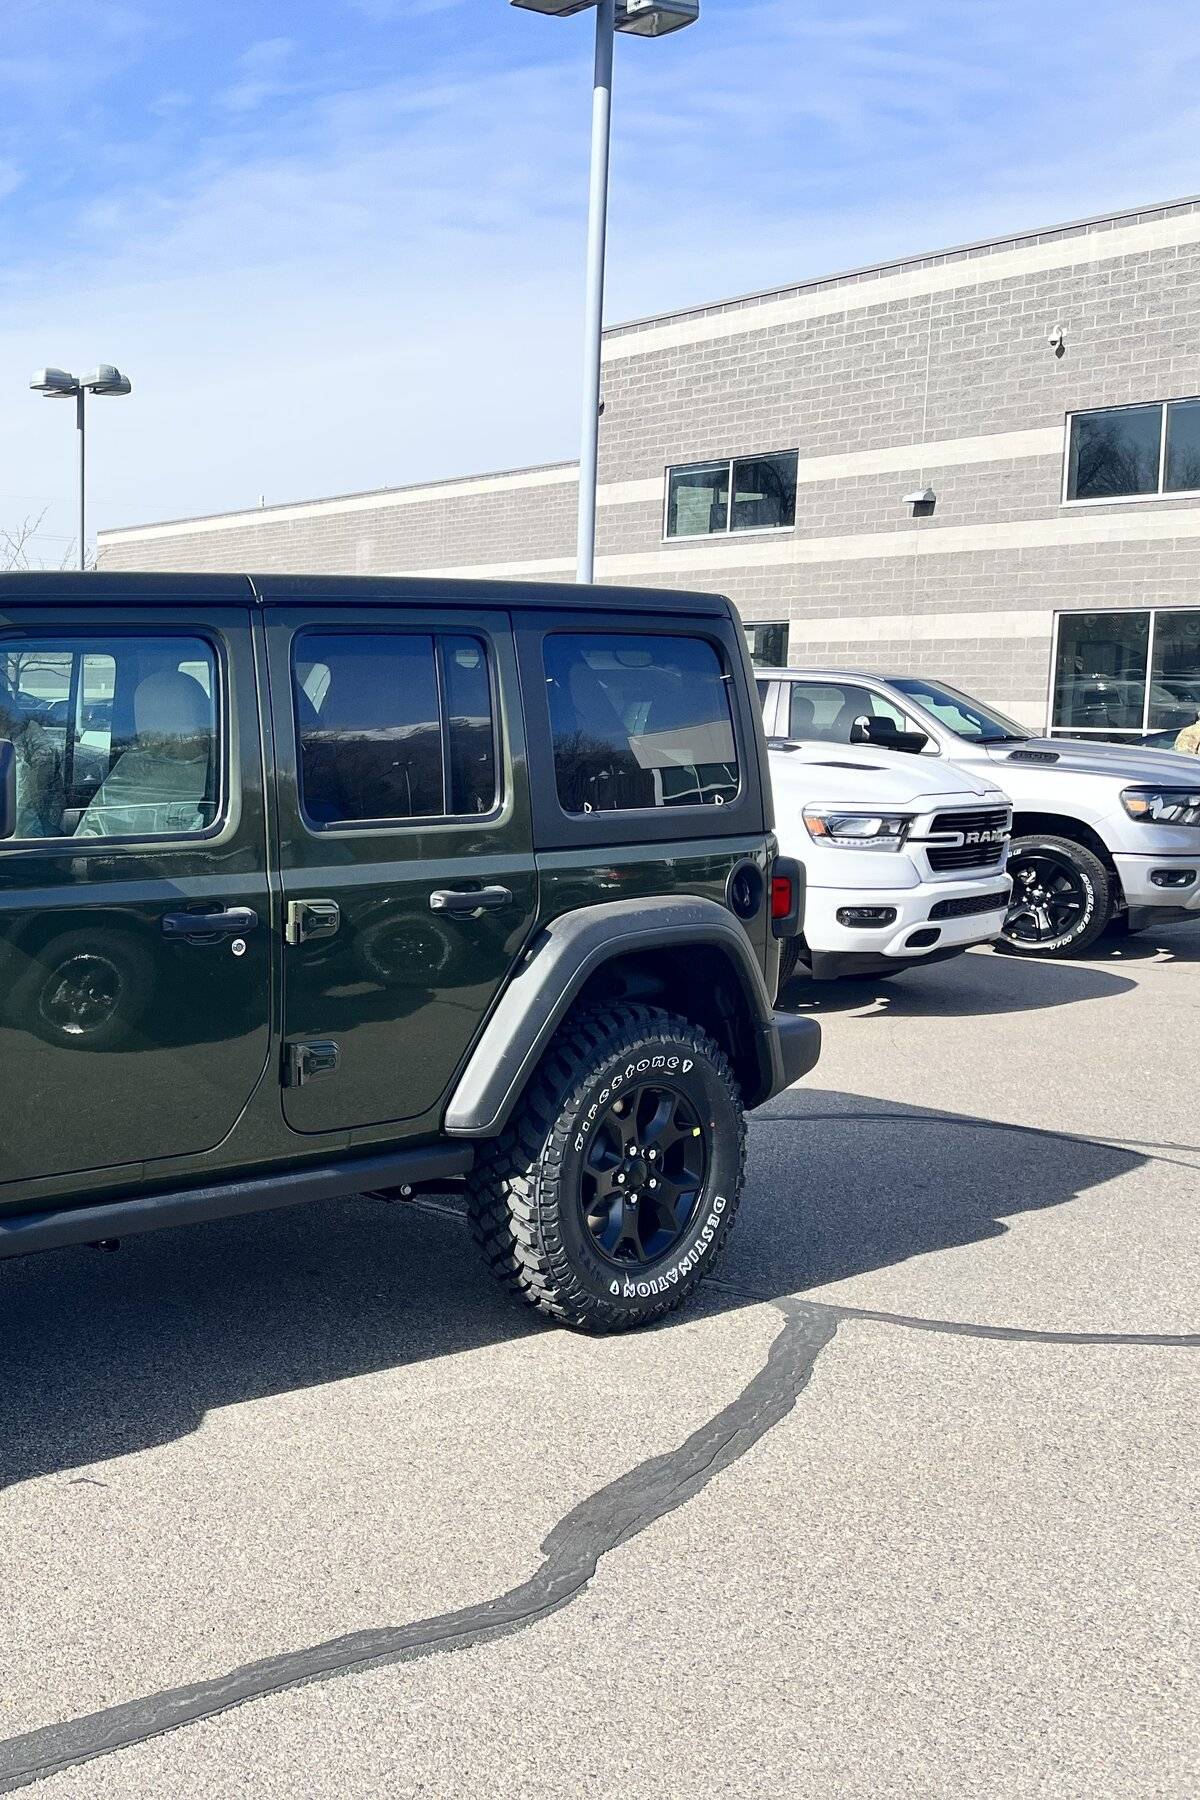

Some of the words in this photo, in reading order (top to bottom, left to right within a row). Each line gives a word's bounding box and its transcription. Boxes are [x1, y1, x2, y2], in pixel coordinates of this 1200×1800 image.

[966, 831, 1005, 844] RAM
[574, 1055, 680, 1152] Firestone
[623, 1196, 726, 1297] DESTINATION
